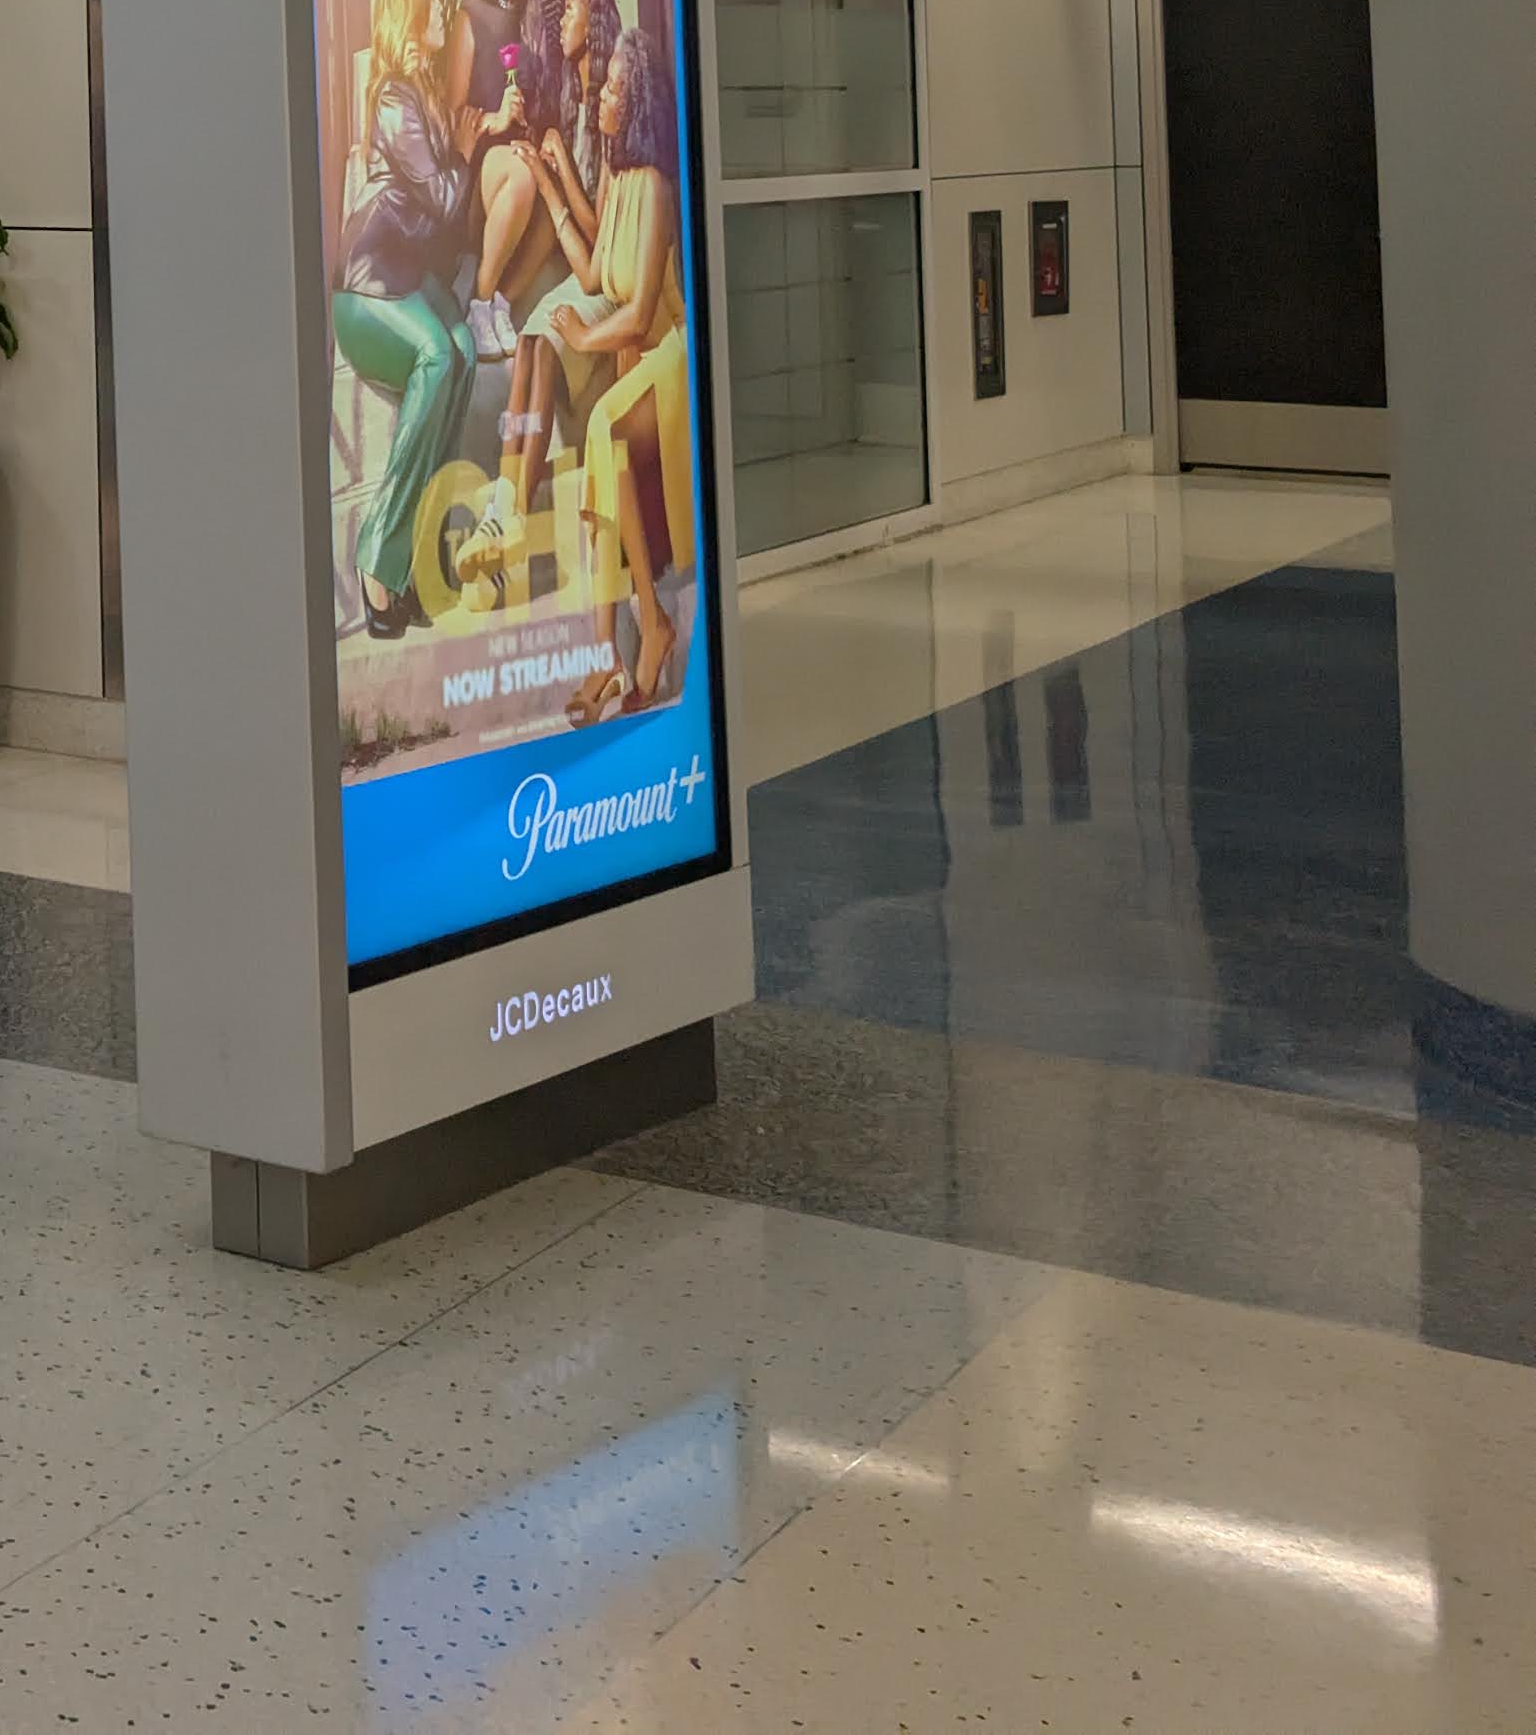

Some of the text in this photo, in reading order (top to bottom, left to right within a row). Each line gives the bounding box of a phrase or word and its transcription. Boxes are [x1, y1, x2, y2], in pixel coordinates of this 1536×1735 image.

[442, 640, 616, 708] NOW STREAMING
[500, 753, 707, 882] Paramount+
[488, 972, 613, 1042] JCDecaux
